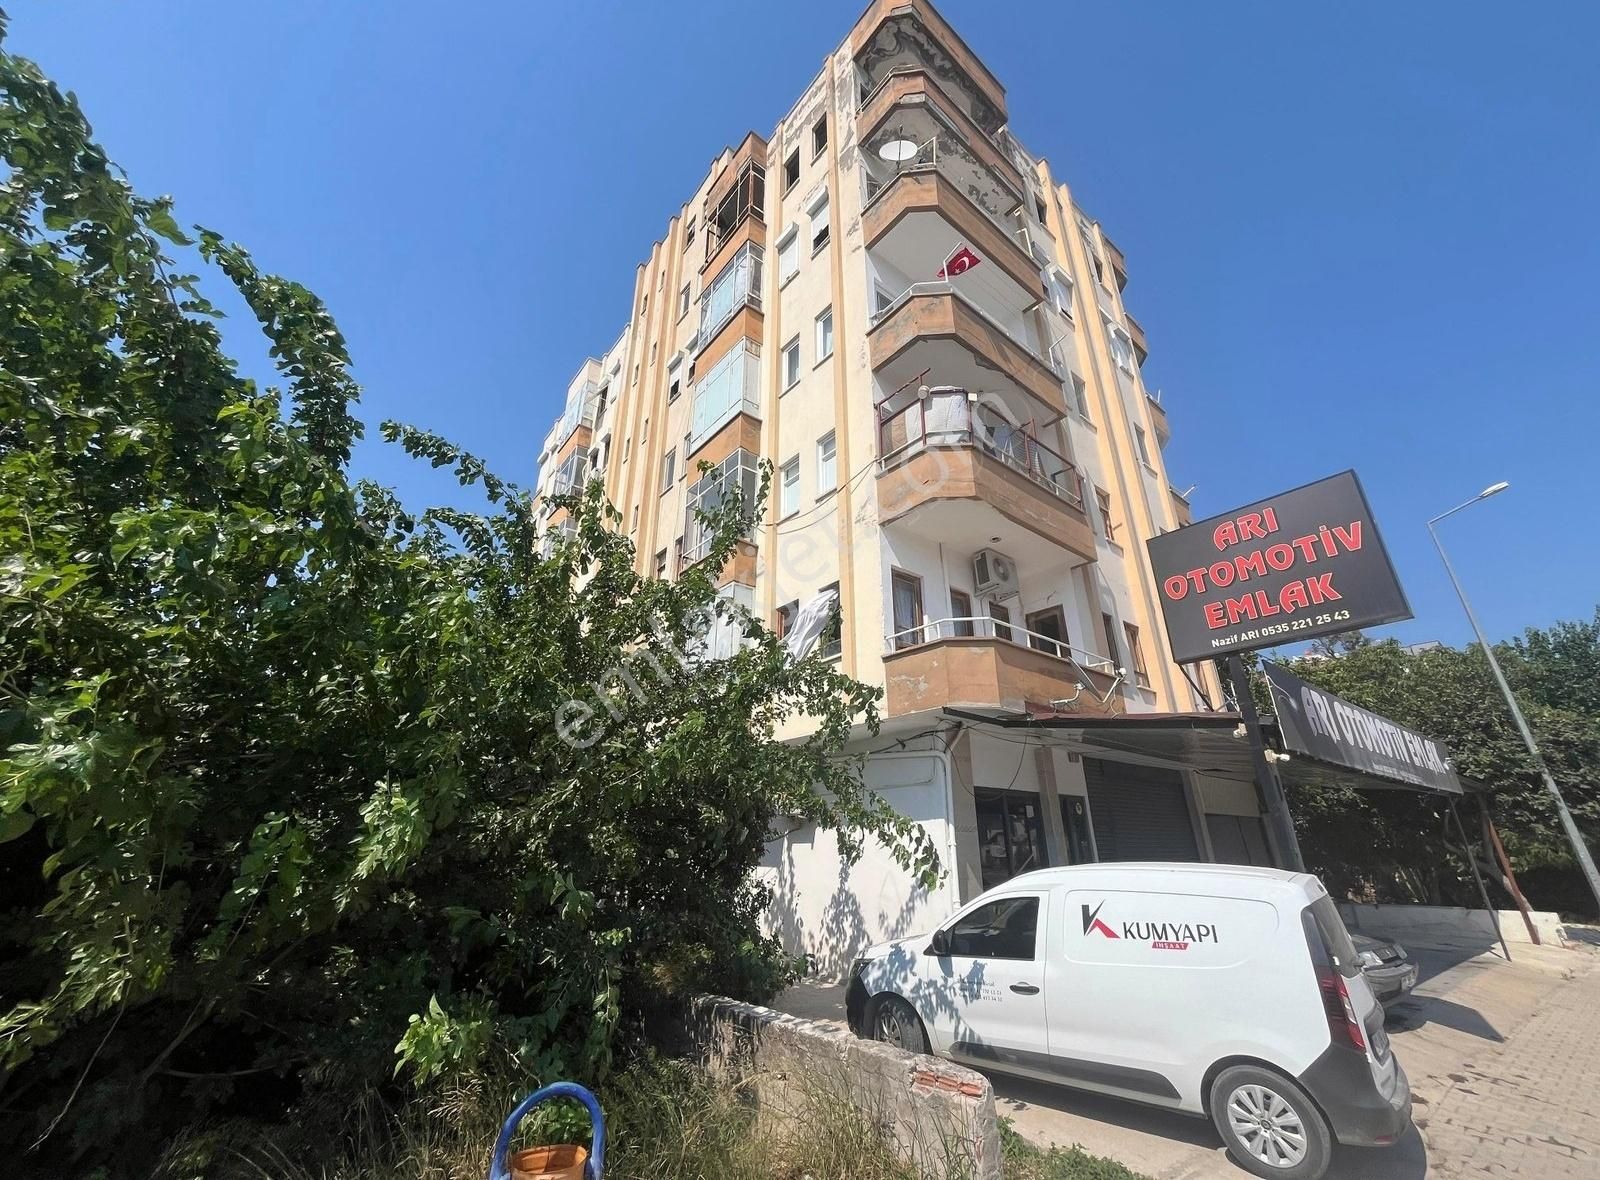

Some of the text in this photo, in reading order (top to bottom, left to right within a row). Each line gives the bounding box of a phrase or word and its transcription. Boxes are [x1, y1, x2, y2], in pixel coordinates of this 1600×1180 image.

[1213, 507, 1279, 551] ARI
[1164, 520, 1362, 600] OTOMOTİV
[1204, 572, 1342, 629] EMLAK
[1211, 609, 1351, 648] Nazif ARI 0535 221 25 43
[1301, 686, 1342, 744] ARI
[1122, 921, 1219, 943] KUMYAPI
